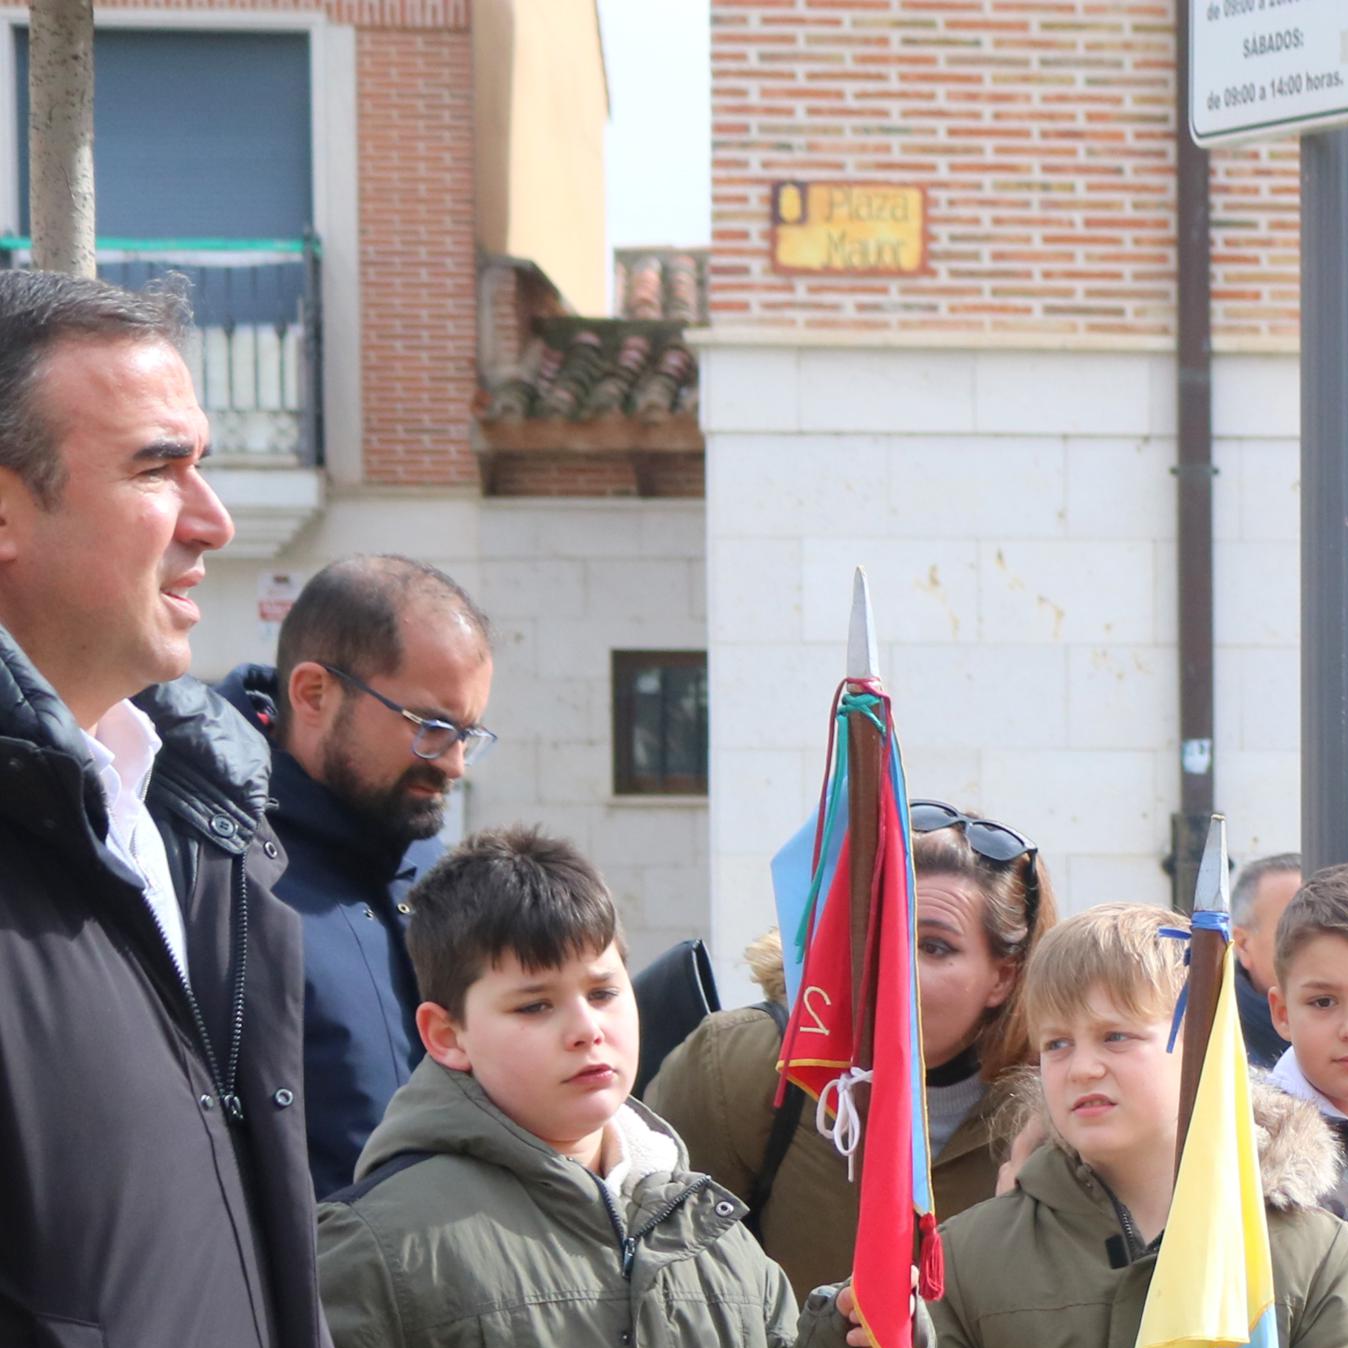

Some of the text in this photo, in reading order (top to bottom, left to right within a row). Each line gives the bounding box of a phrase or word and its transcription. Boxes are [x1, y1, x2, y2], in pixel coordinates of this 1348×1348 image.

[1242, 28, 1304, 58] SÁBADOS:
[1206, 69, 1344, 110] de 09:00 a 14:00 horas.
[825, 187, 909, 223] Plaza
